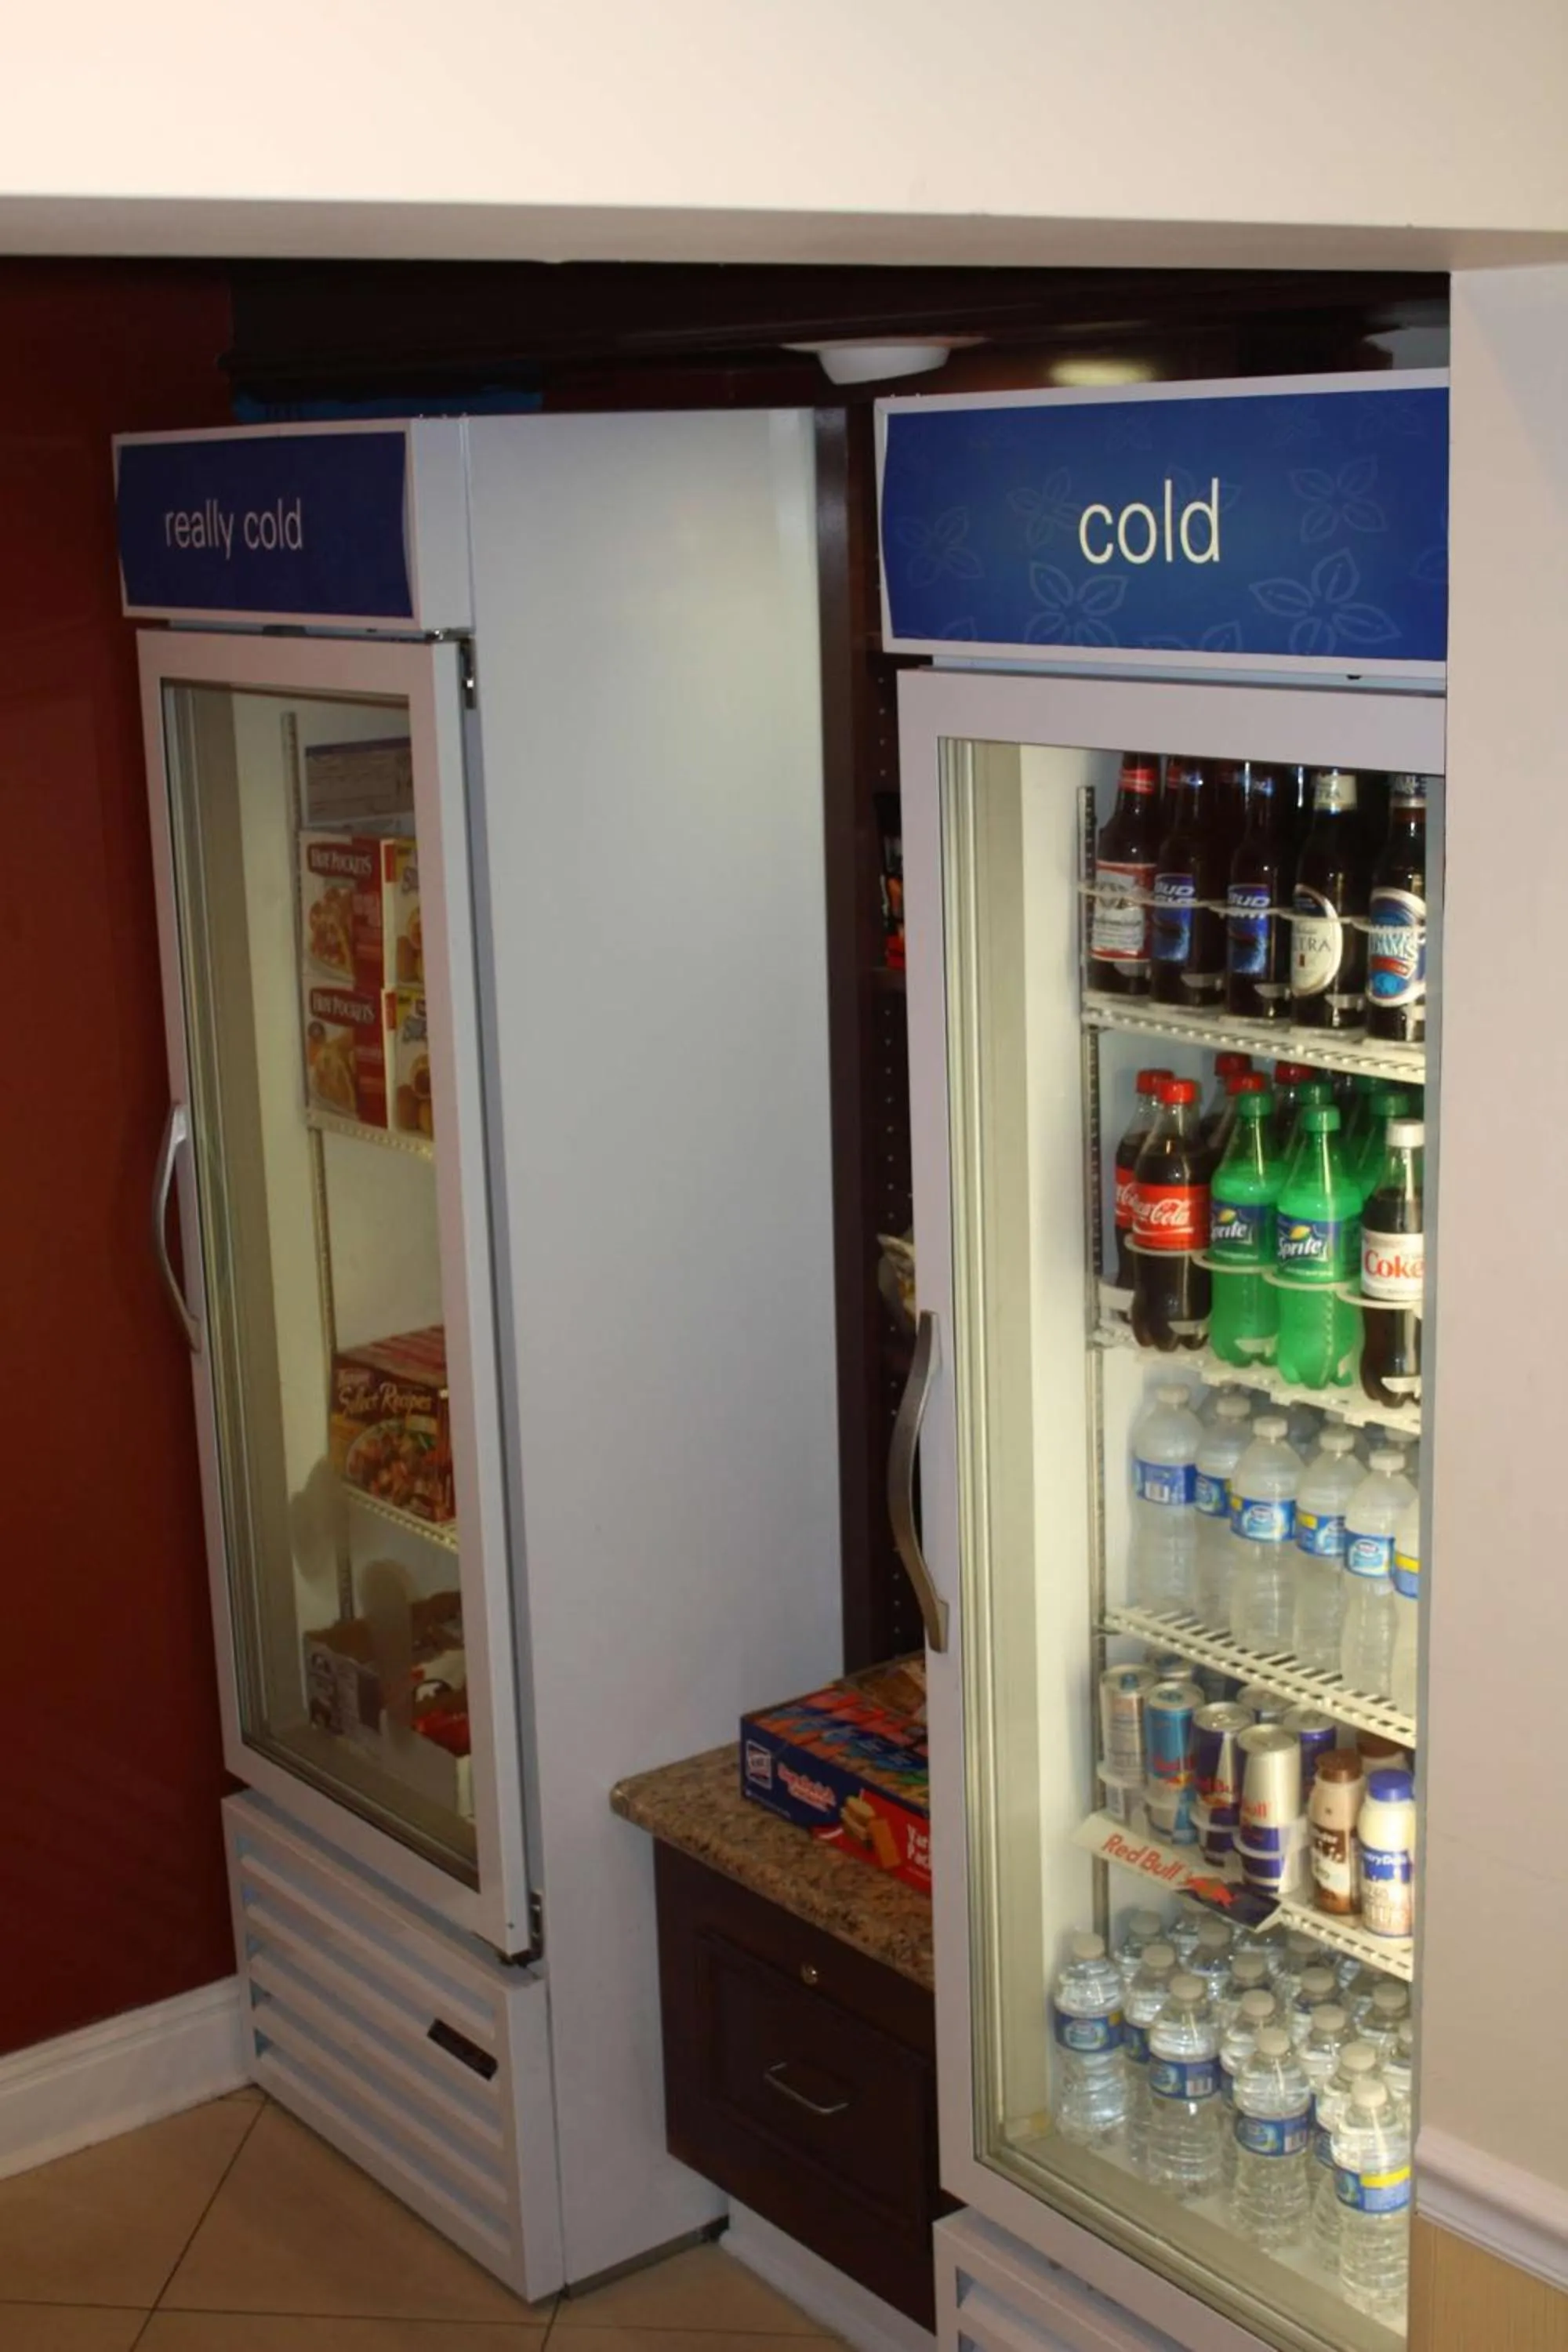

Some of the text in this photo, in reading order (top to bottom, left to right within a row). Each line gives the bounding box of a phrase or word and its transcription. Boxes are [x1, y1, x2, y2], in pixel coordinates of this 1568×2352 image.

[163, 498, 303, 560] really cold
[1079, 477, 1221, 564] cold
[1211, 1221, 1247, 1242] prite
[1279, 1236, 1323, 1260] Sprite
[1364, 1249, 1425, 1279] Coke
[1101, 1833, 1185, 1881] Red Bull
